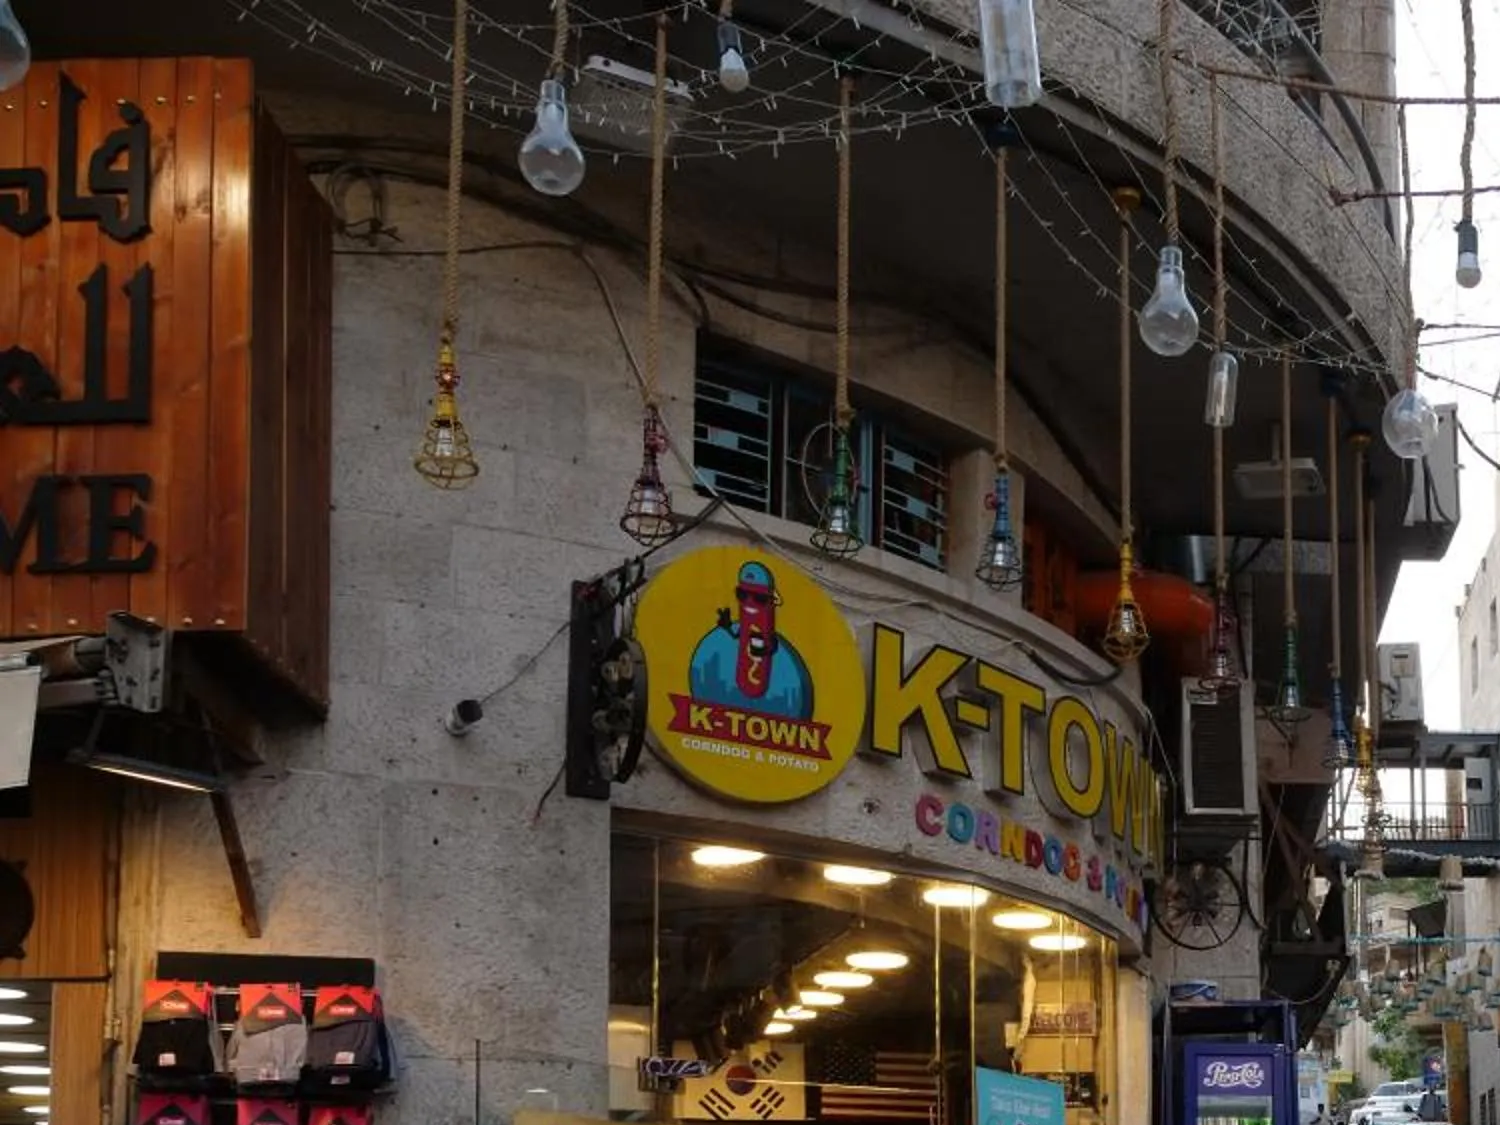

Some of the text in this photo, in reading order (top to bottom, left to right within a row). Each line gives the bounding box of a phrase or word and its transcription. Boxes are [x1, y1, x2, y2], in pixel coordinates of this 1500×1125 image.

[681, 737, 751, 763] CORNDOG
[768, 754, 820, 774] POTATO
[689, 703, 821, 752] K-TOWN
[870, 622, 1166, 877] K-TOWN
[915, 794, 1081, 882] CORNDOG
